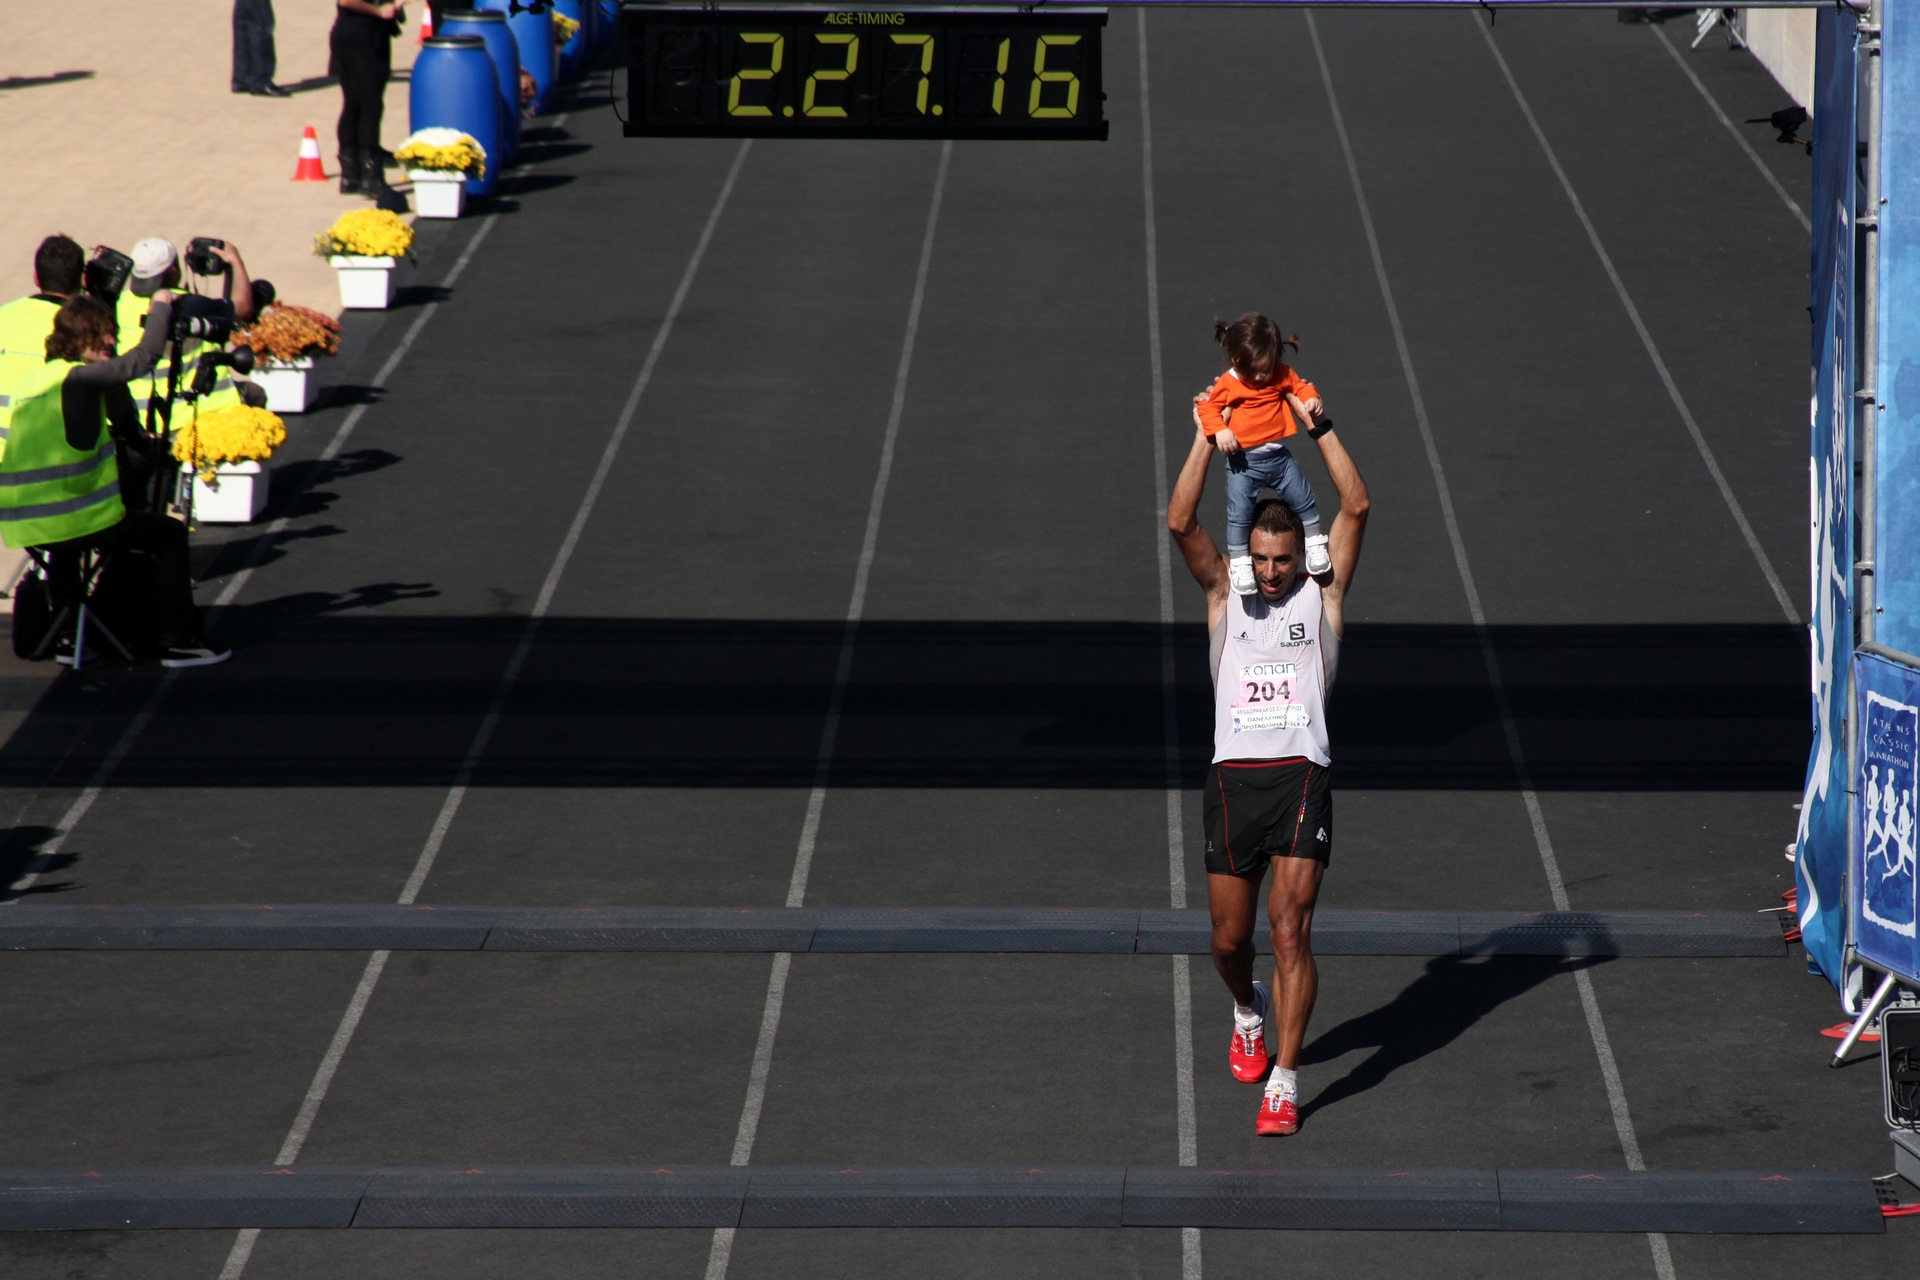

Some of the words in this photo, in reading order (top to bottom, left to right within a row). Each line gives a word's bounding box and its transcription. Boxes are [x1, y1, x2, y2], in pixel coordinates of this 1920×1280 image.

[823, 12, 905, 25] ALGE-TIMING
[1246, 679, 1290, 703] 204
[1869, 751, 1909, 769] MARATHON
